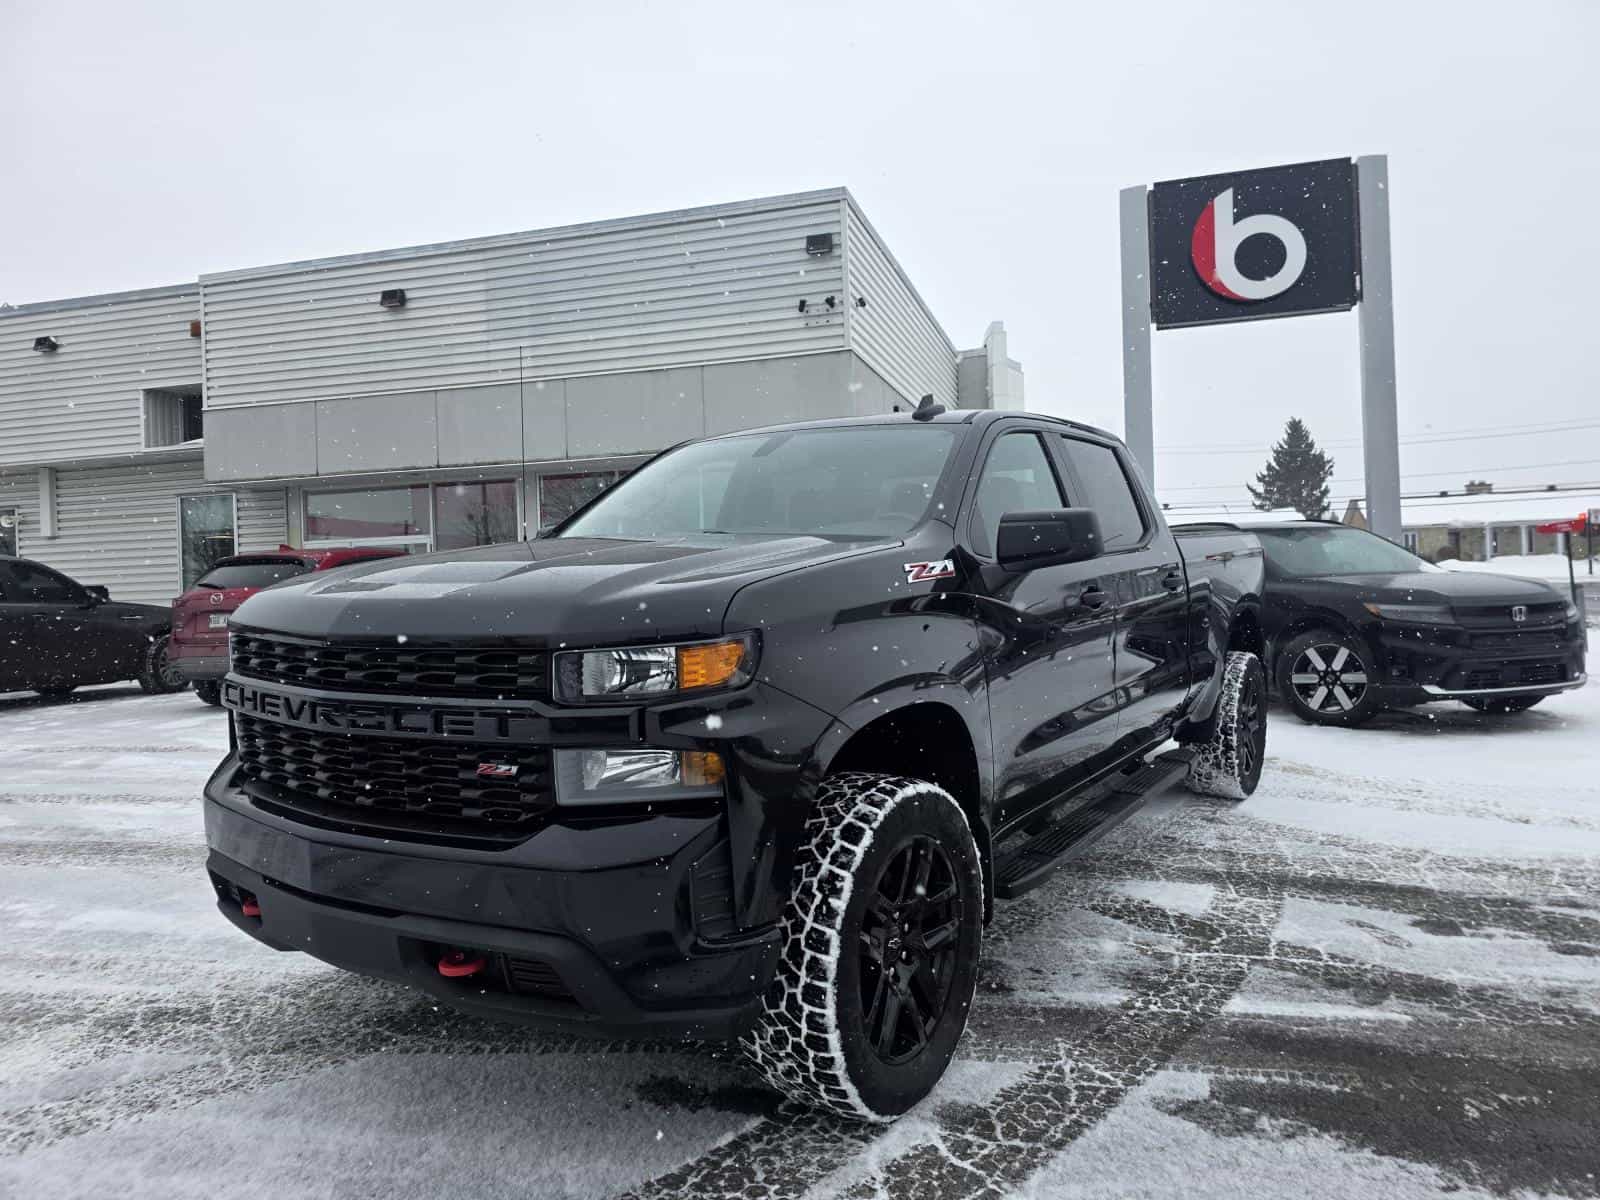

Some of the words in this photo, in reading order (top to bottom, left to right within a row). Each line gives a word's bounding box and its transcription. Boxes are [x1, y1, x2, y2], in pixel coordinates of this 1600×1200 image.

[1213, 187, 1307, 300] b
[903, 559, 956, 584] Z71
[223, 681, 528, 738] CHEVROLET
